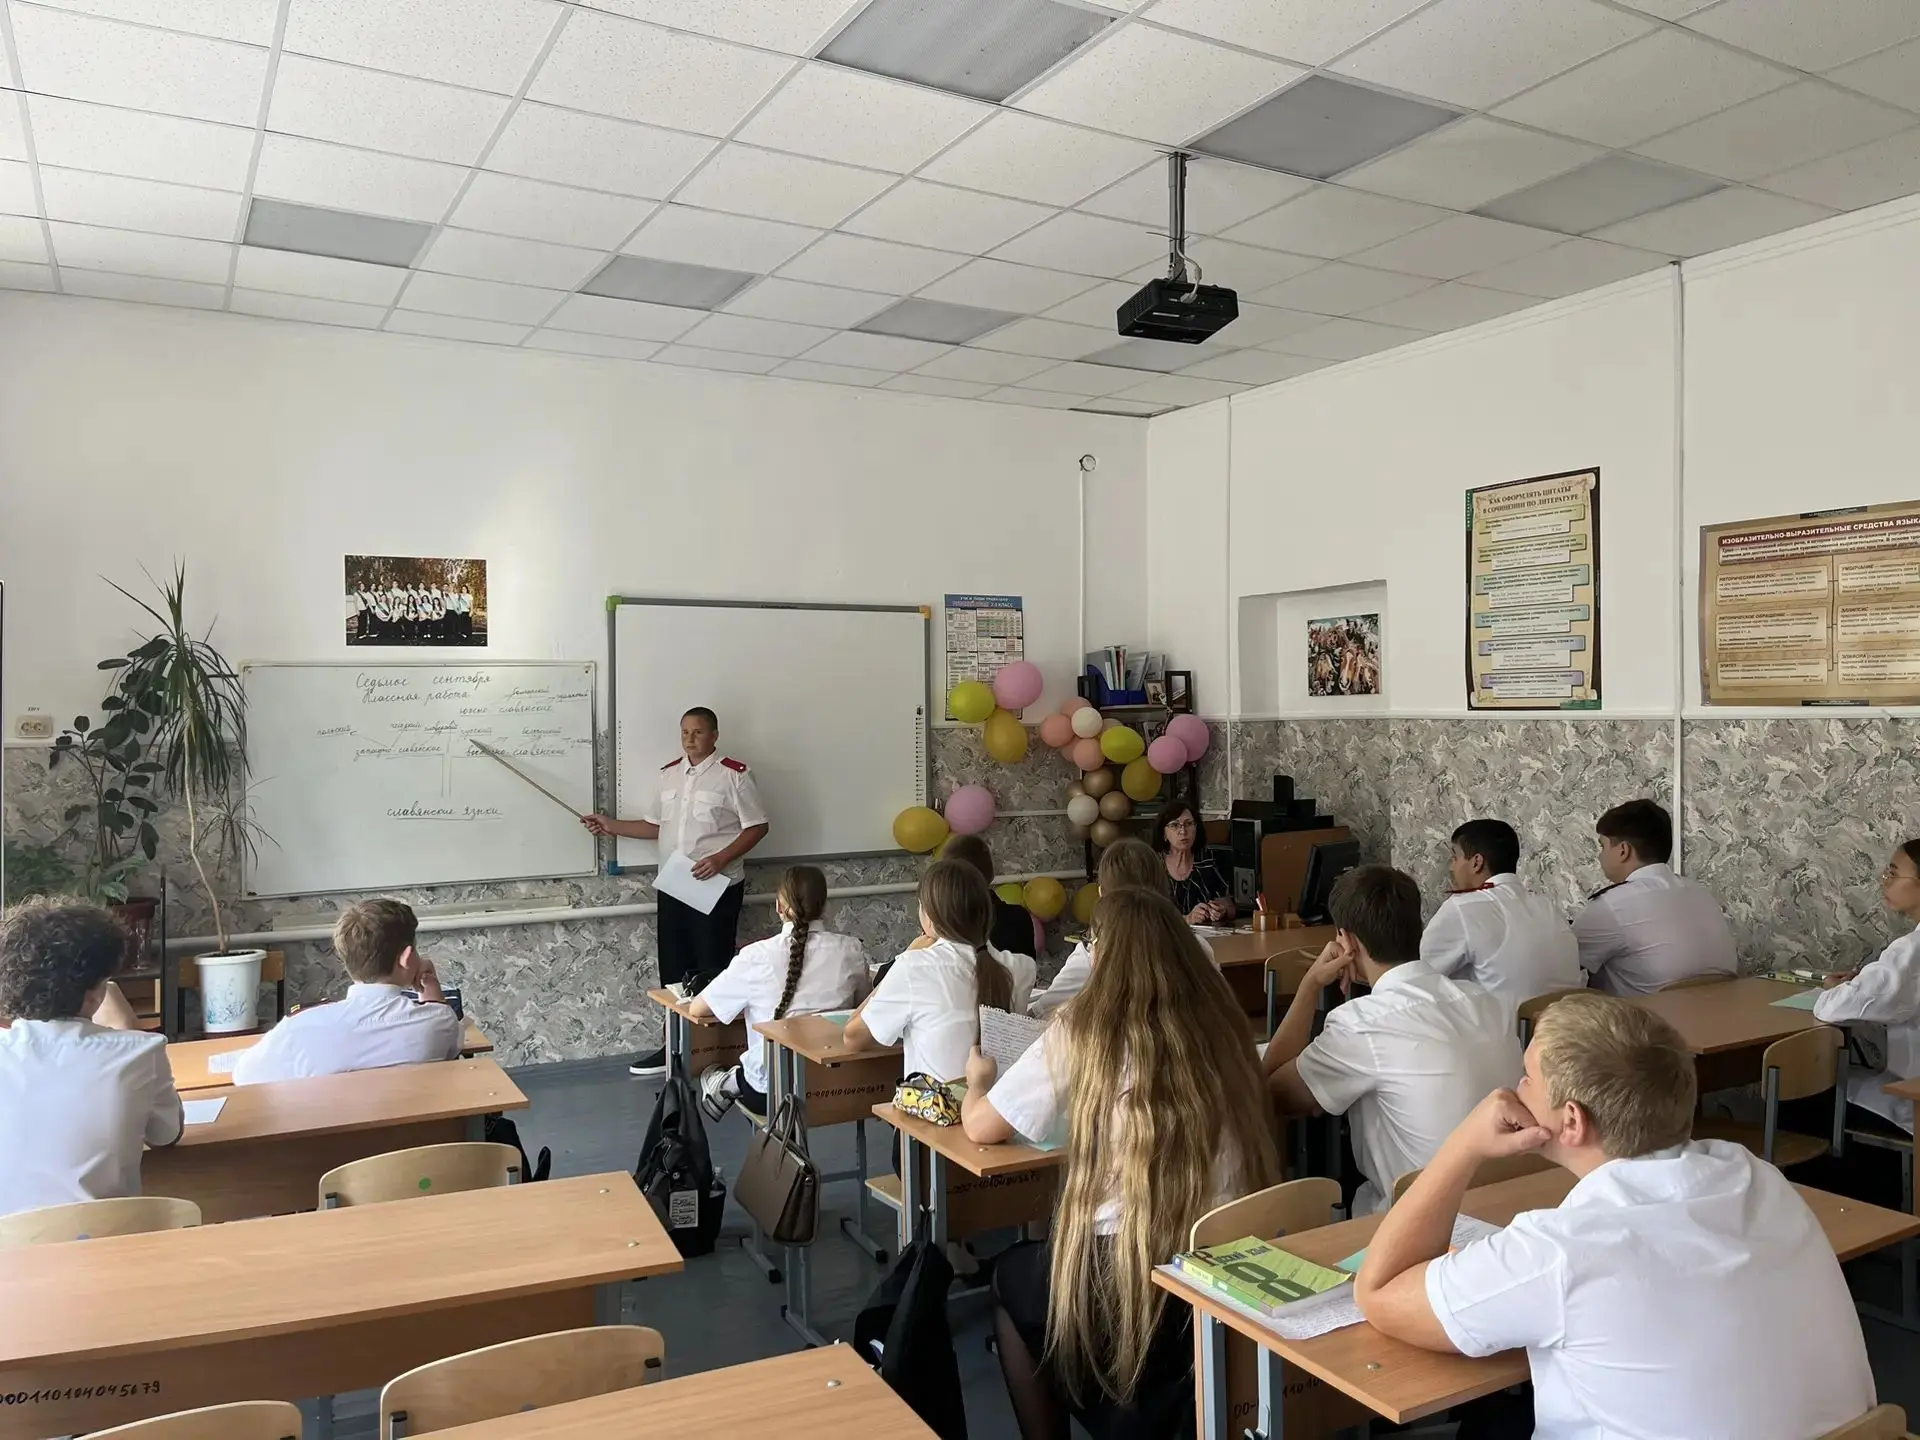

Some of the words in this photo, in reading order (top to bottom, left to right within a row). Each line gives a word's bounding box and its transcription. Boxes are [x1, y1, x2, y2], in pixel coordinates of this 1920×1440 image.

[1722, 525, 1851, 544] ИЗОБРАЗИТЕЛЬНО-ВЫРАЗИТЕЛЬНЫЕ
[1853, 520, 1894, 530] СРЕДСТВА
[356, 672, 410, 693] Седьмое
[433, 671, 491, 691] сентября
[1222, 1261, 1318, 1303] 8
